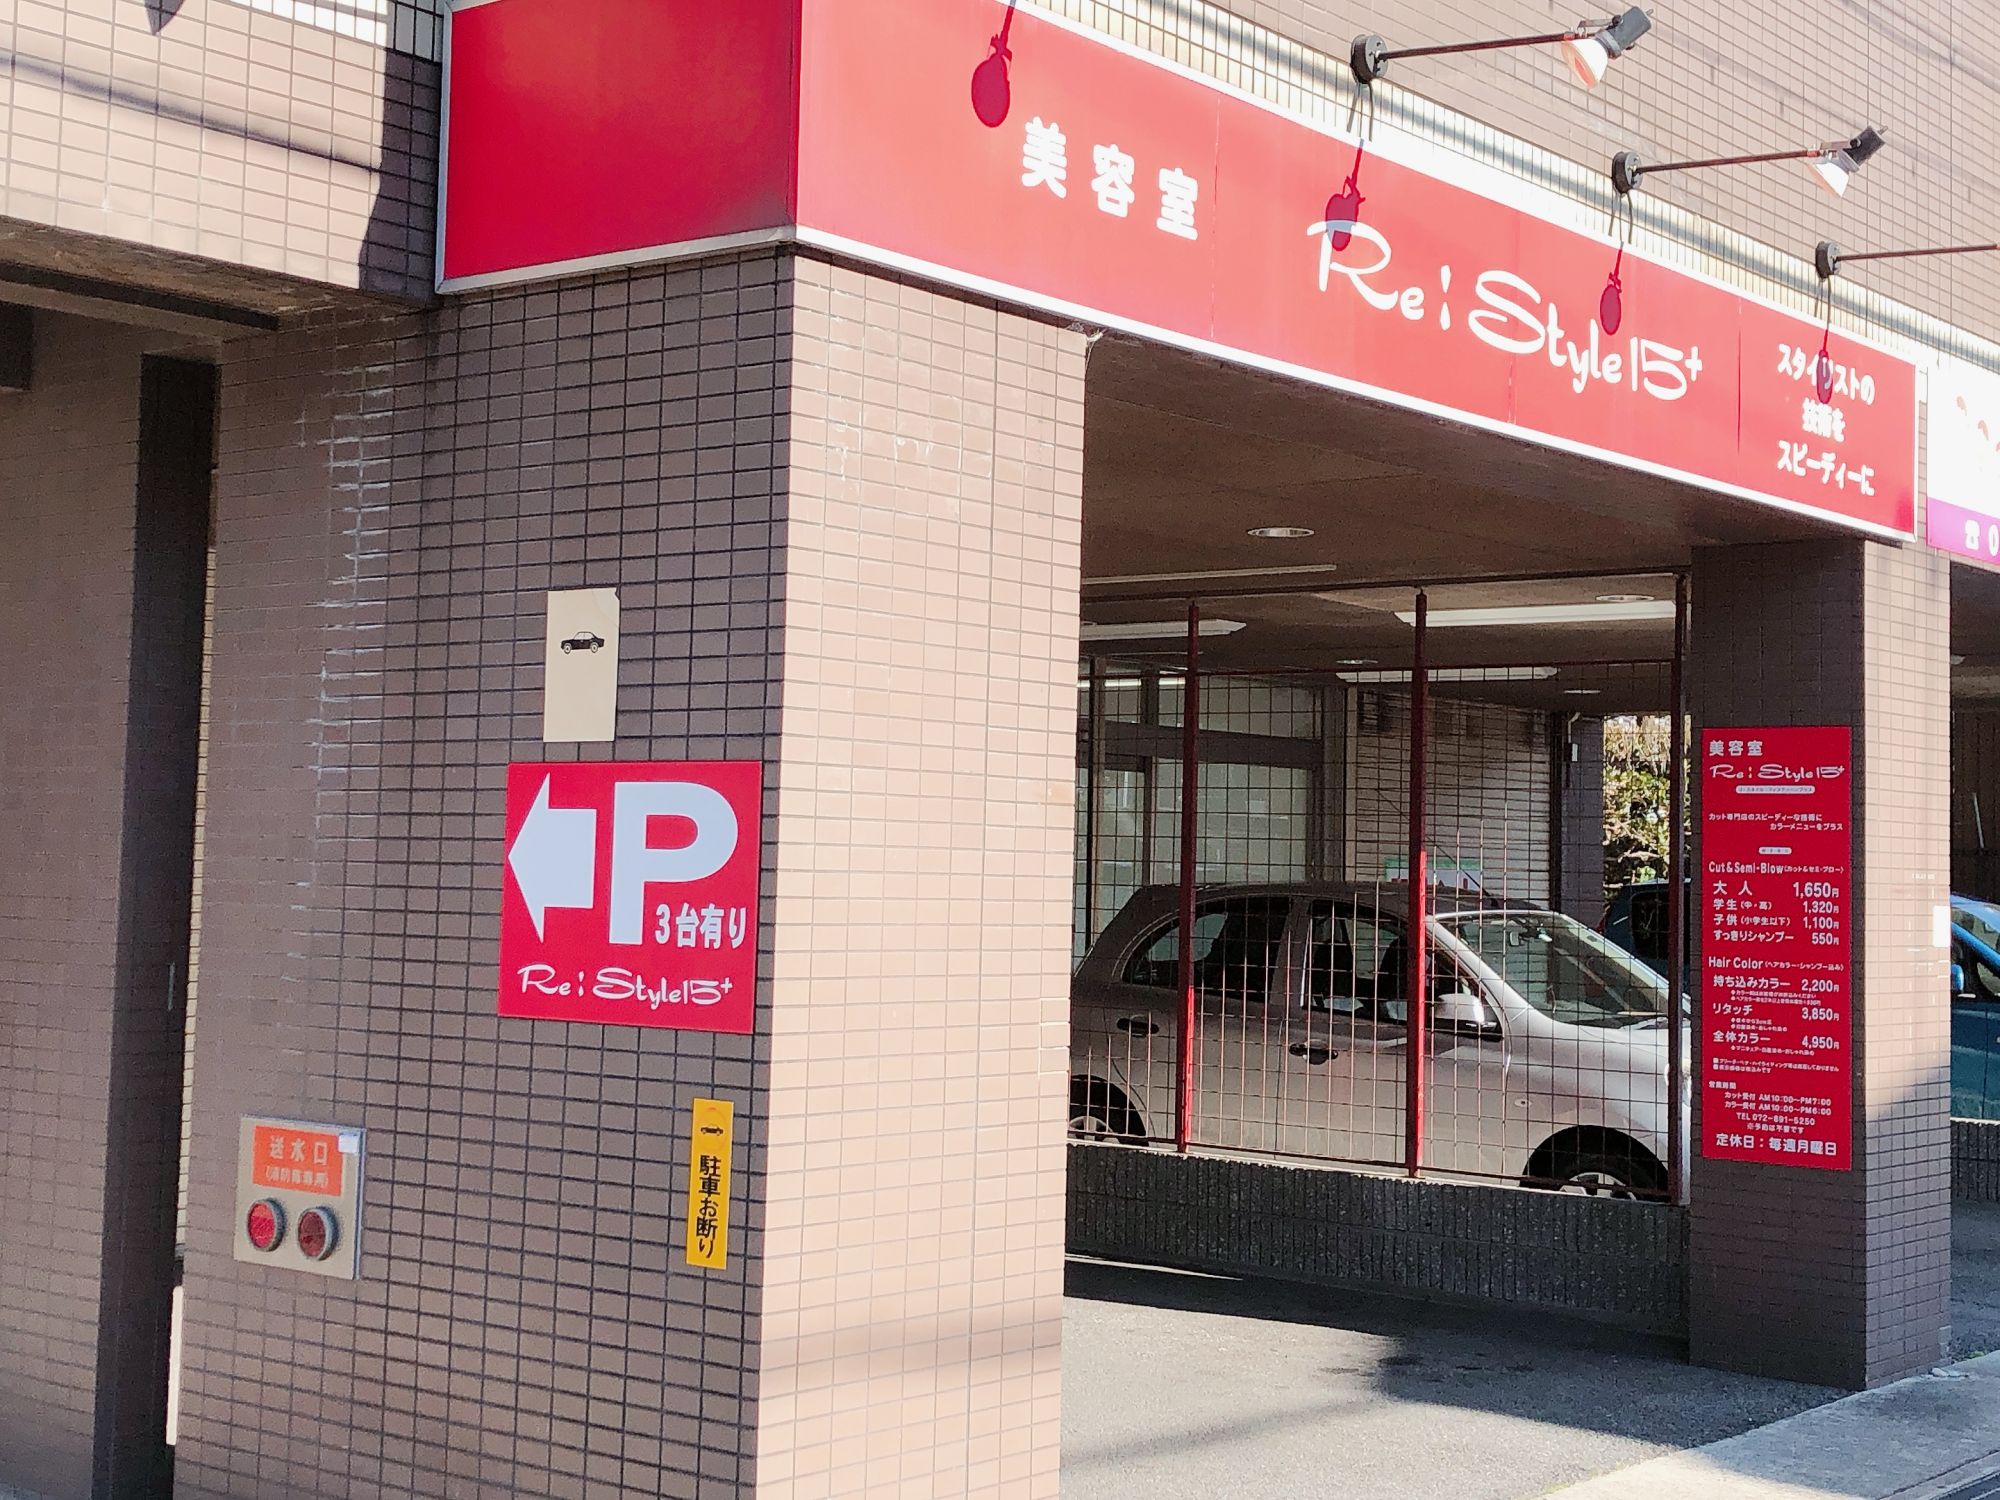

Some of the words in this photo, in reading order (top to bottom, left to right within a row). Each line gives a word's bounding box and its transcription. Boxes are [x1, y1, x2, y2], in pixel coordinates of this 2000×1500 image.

[1021, 116, 1198, 241] 美容室
[1777, 343, 1876, 406] スタイリストの
[1801, 397, 1847, 442] 技術を
[1777, 439, 1876, 497] スピーディーに
[1708, 739, 1764, 757] 美容室
[1769, 822, 1844, 831] カラーメニューをプラス
[609, 781, 739, 945] P
[1793, 881, 1840, 899] 1,650円
[1802, 900, 1840, 914] 1,320円
[654, 901, 747, 950] 3台有り
[1802, 916, 1840, 930] 1,100円
[1712, 929, 1795, 943] すっきりシャンプー
[1811, 932, 1840, 946] 550円
[1708, 956, 1731, 968] Hair
[1733, 956, 1764, 969] Color
[1713, 974, 1791, 989] 持ち込みカラー
[1801, 978, 1840, 993] 2,200円
[1712, 1003, 1753, 1016] リタッチ
[1801, 1007, 1840, 1022] 3,850円
[1712, 1030, 1771, 1044] 全体カラー
[1801, 1035, 1840, 1050] 4,950円
[1708, 1080, 1737, 1090] 営業時間
[1724, 1091, 1756, 1101] カット受付
[1724, 1101, 1756, 1111] カラー受付
[1736, 1112, 1750, 1121] TEL
[269, 1134, 328, 1166] 送水口
[695, 1154, 722, 1259] 駐車お断り
